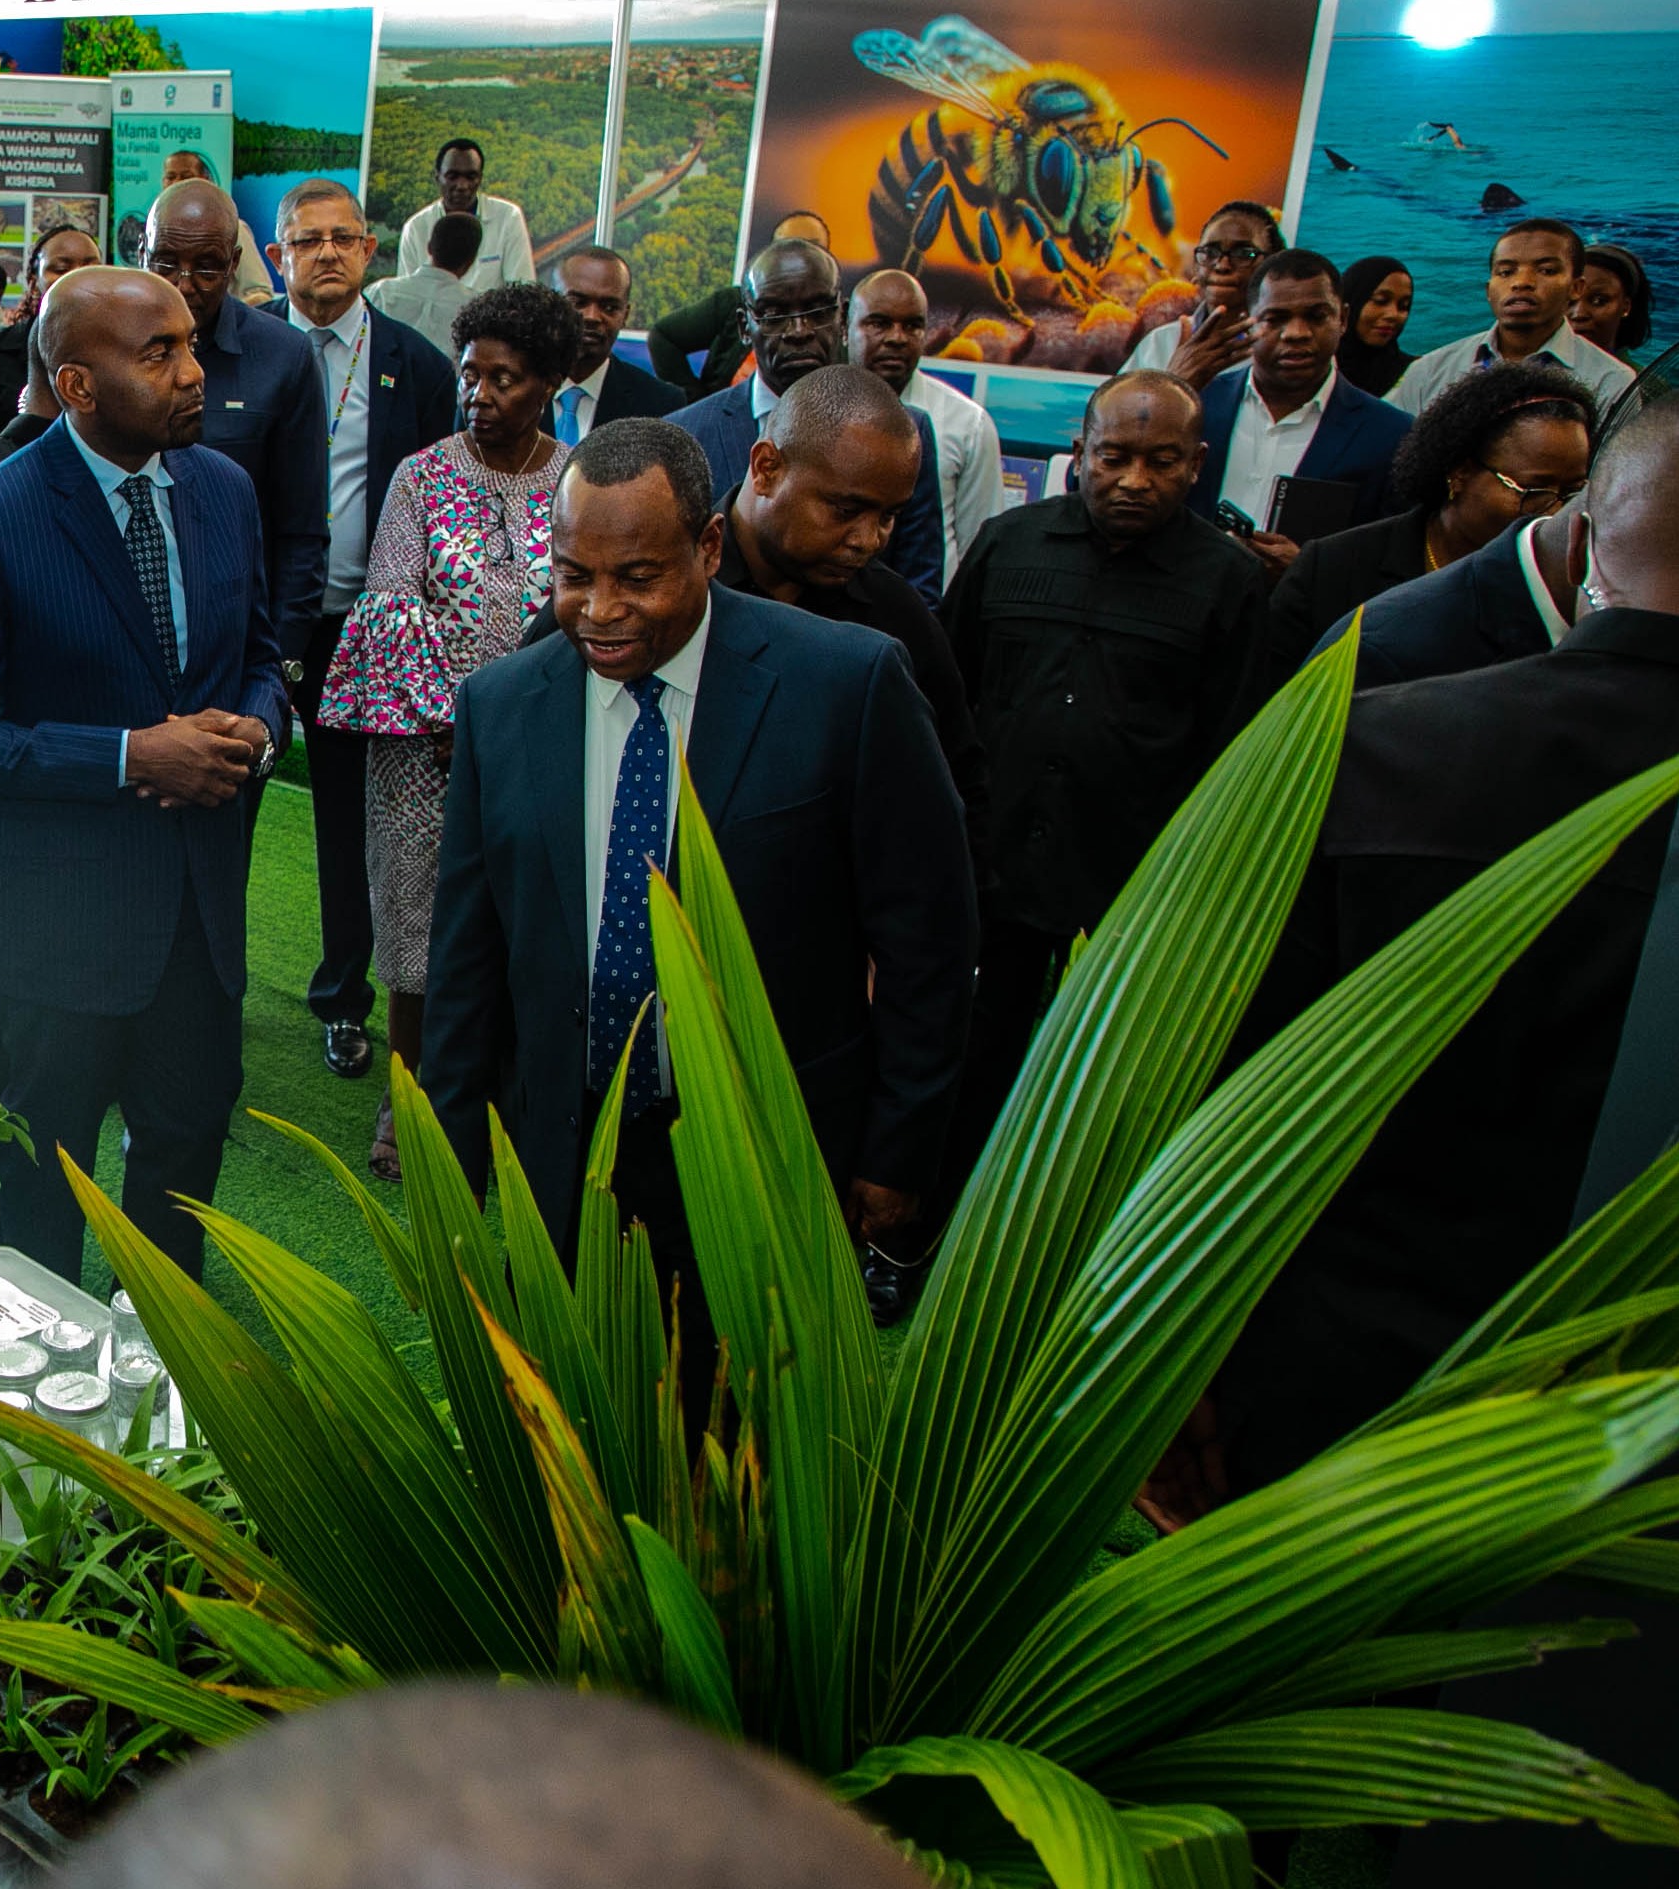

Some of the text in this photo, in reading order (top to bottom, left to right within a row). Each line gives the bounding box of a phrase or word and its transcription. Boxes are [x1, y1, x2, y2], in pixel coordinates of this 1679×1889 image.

[54, 131, 99, 145] WAKALI
[116, 122, 202, 143] Mama Ongea
[6, 145, 76, 159] WAHARIBIFU
[5, 175, 56, 188] KISHERIA
